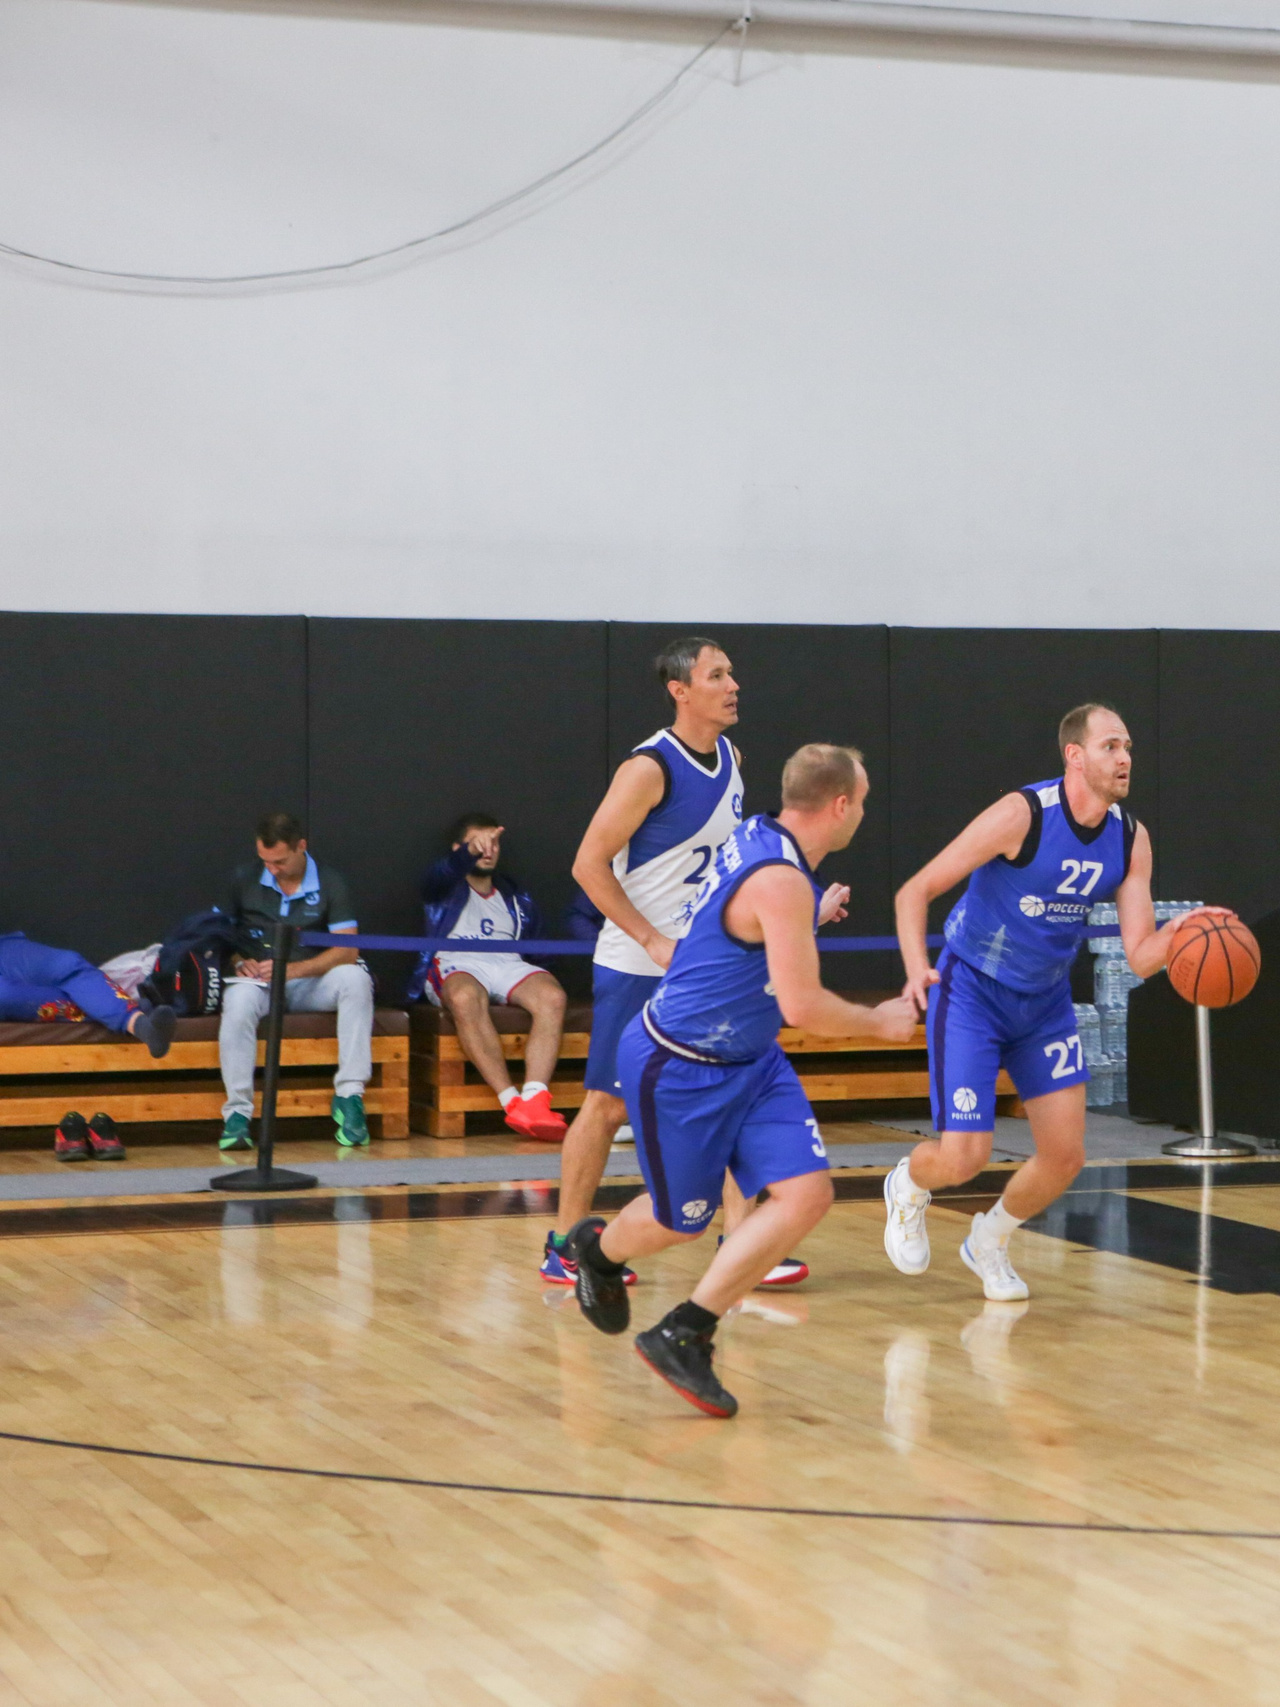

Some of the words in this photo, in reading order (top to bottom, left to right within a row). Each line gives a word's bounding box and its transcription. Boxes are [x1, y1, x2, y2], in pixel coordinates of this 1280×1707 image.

[683, 841, 727, 885] 2
[1056, 859, 1104, 897] 27
[480, 918, 494, 936] 6
[204, 966, 221, 1014] RUSSI
[1043, 1034, 1083, 1080] 27
